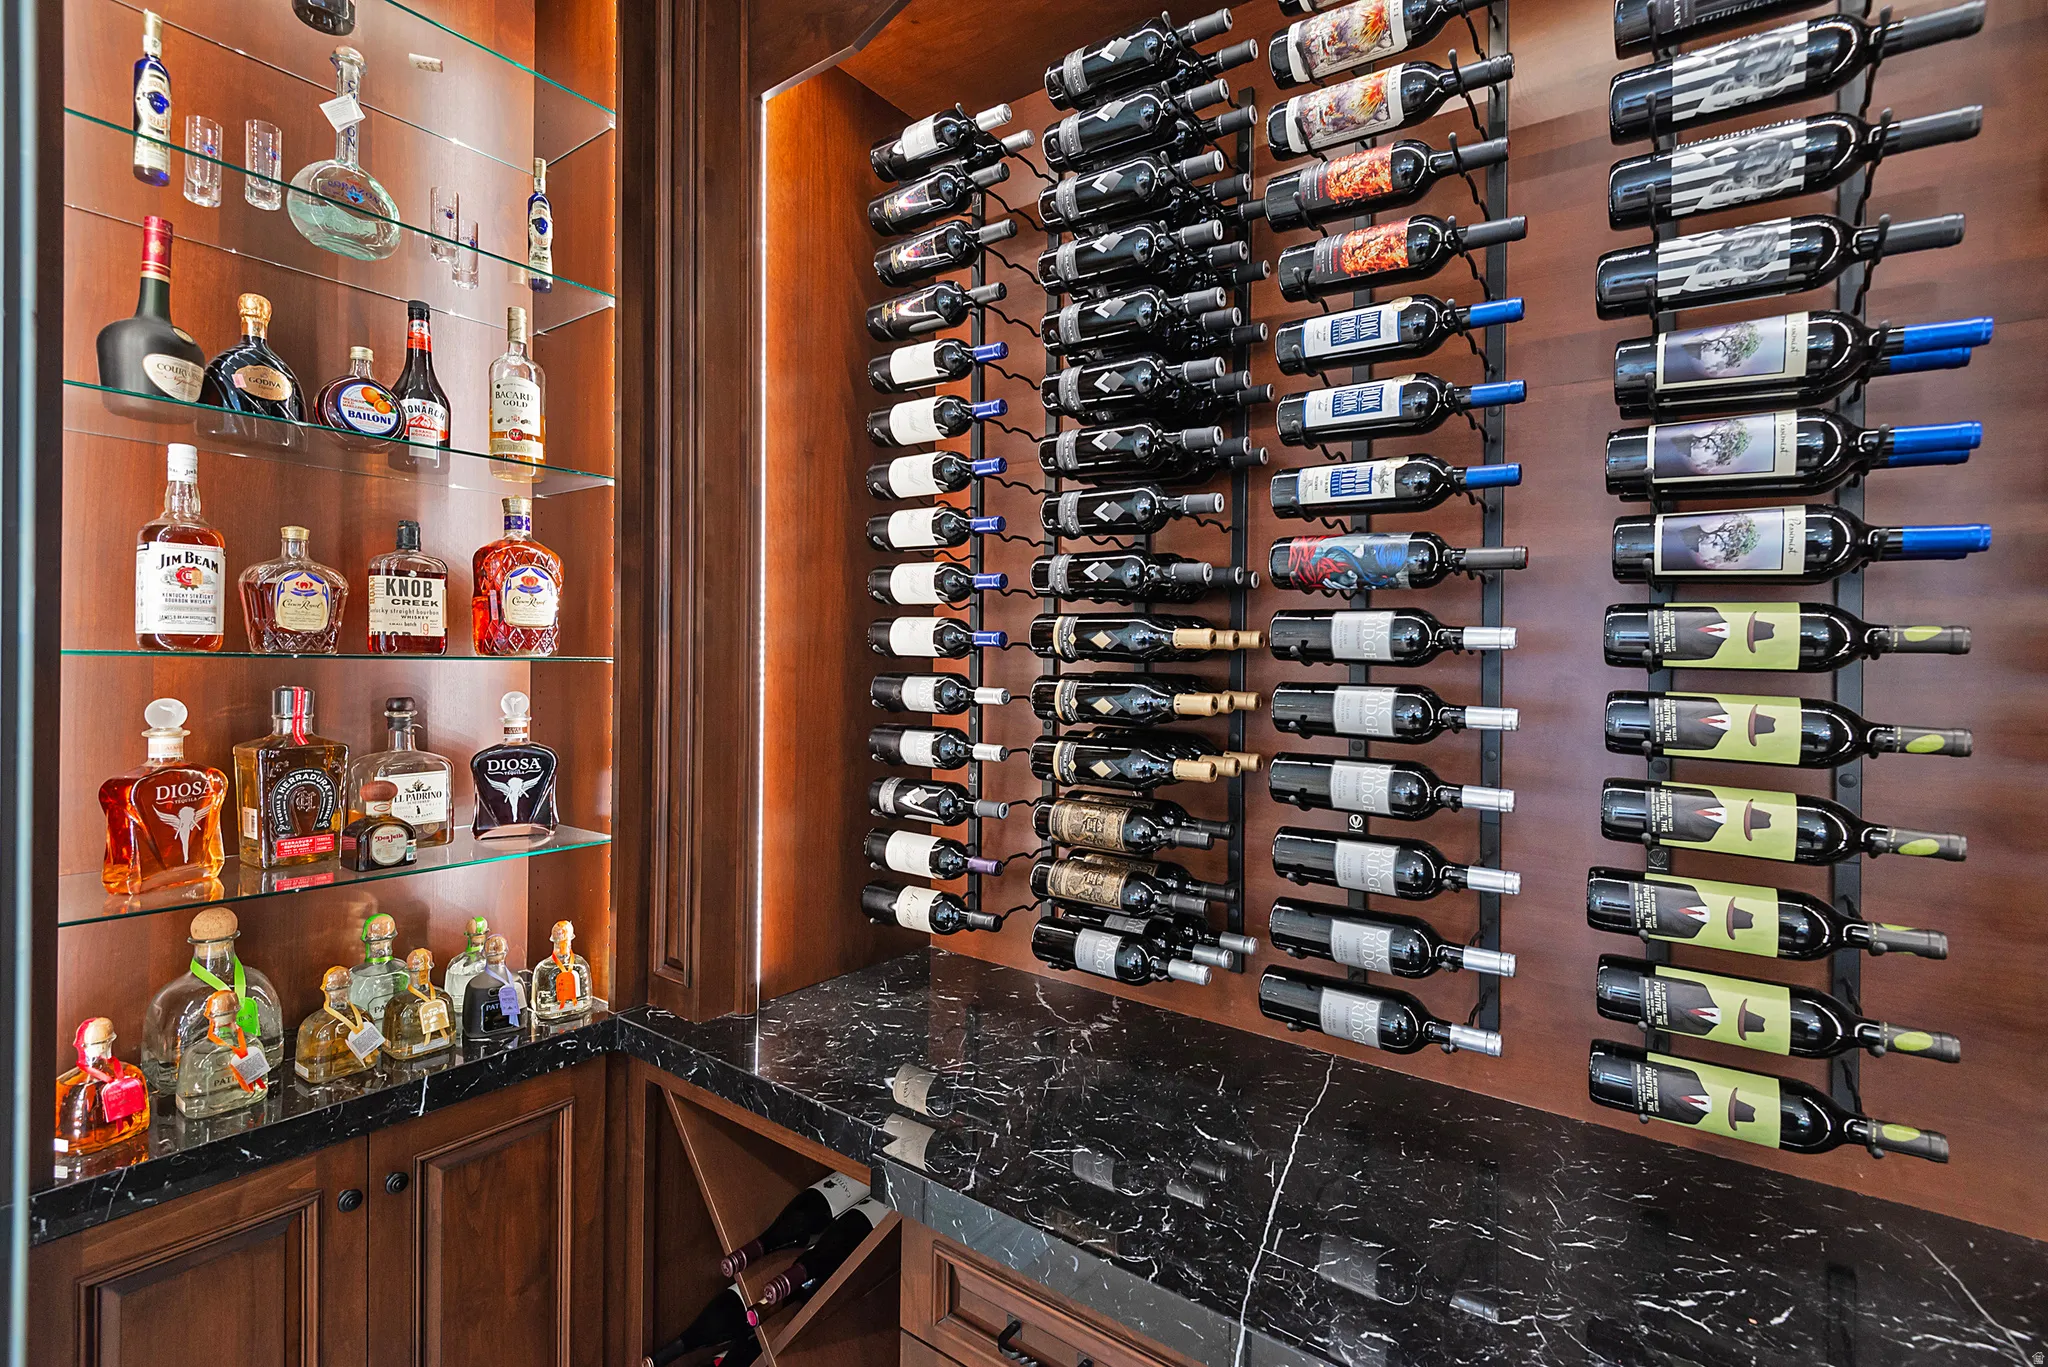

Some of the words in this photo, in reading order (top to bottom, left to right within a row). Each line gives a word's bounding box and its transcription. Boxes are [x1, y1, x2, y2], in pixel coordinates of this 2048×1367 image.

[248, 376, 281, 390] GODIVA
[502, 400, 528, 408] GOLD
[348, 410, 392, 426] BAILONI
[156, 552, 182, 570] JIM
[185, 551, 218, 574] BEAM
[386, 578, 432, 598] KNOB
[391, 598, 438, 607] CREEK
[1376, 612, 1392, 640] OAK
[1362, 614, 1378, 659] RIDGE
[1378, 688, 1394, 716] OAK
[487, 758, 541, 772] DIOSA
[278, 773, 332, 793] HERRADURA
[1362, 767, 1376, 812] RIDGE
[1374, 765, 1390, 794] OAK
[156, 781, 214, 801] DIOSA
[406, 791, 442, 802] PADRINO
[1380, 847, 1395, 882] OAK
[1105, 936, 1120, 961] OAK
[1376, 930, 1389, 966] OAK
[486, 1004, 500, 1012] PAT
[1365, 1000, 1378, 1036] OAK
[214, 1076, 232, 1088] PAT
